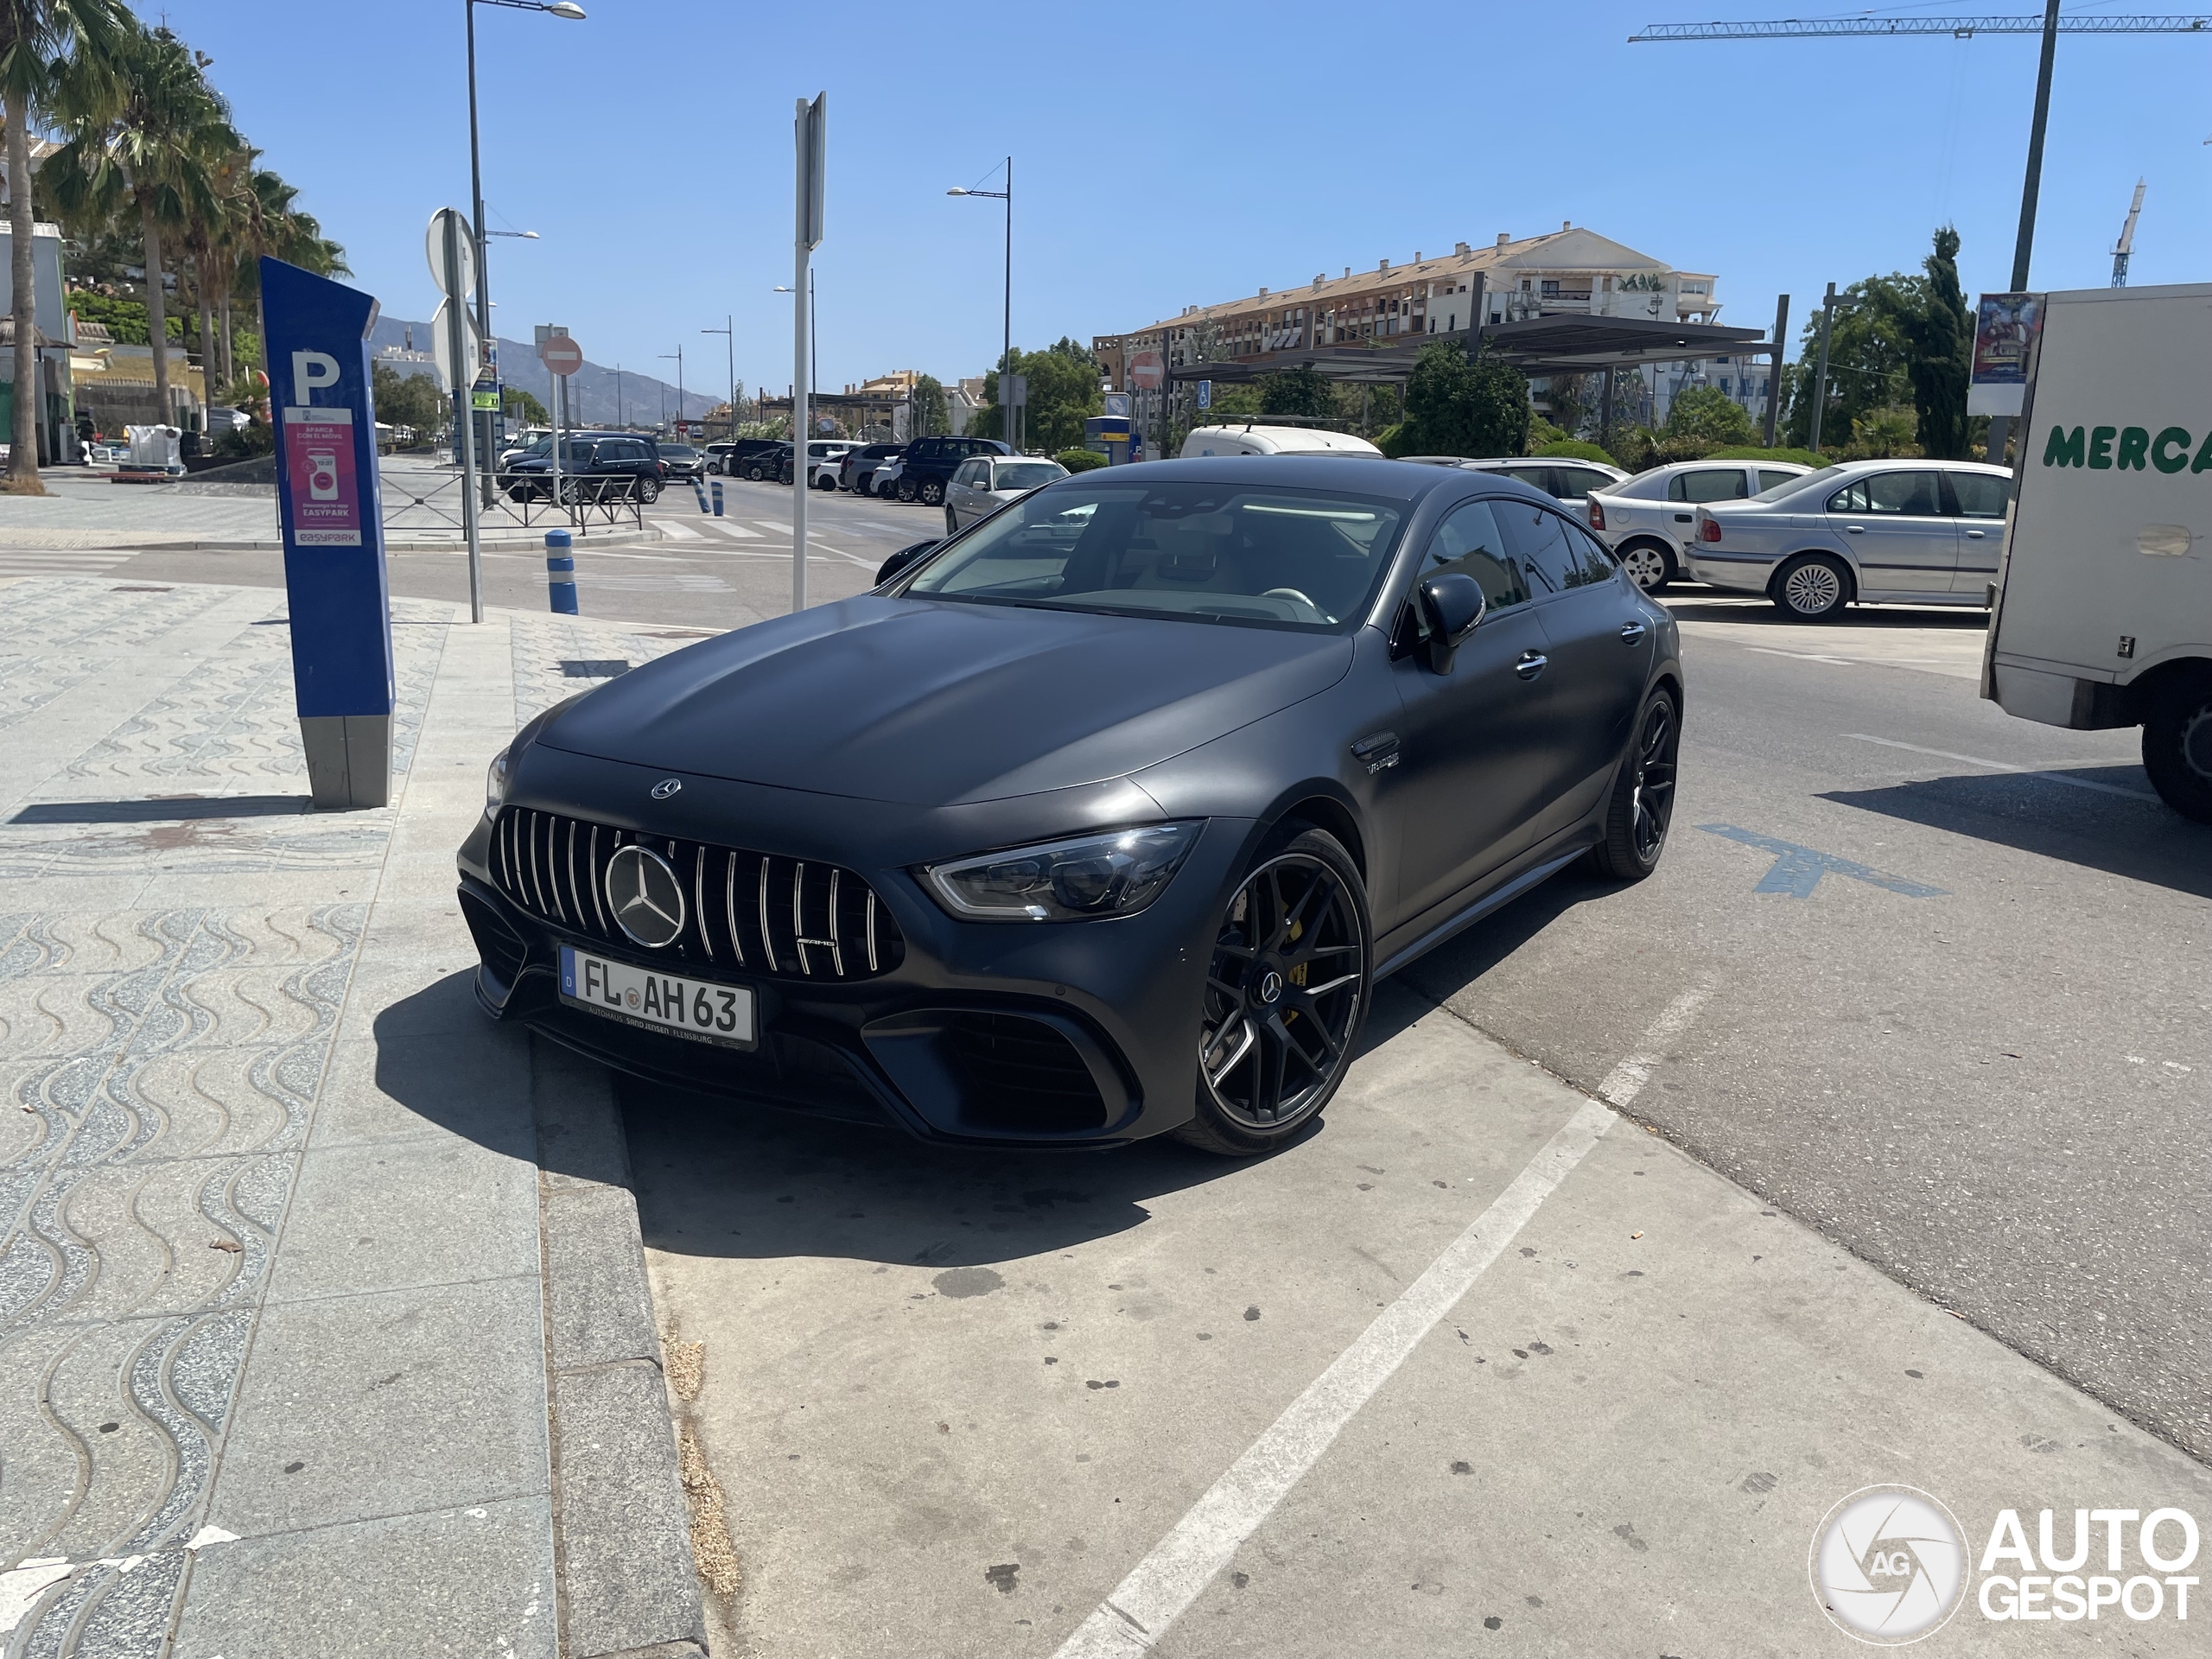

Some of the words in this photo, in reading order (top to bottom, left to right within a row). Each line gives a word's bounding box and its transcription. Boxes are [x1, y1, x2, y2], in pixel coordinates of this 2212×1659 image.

[291, 351, 340, 406] P
[565, 976, 572, 988] D
[585, 959, 621, 1006] FL
[644, 976, 685, 1023] AH
[693, 988, 736, 1032] 63
[588, 1006, 624, 1022] AUTOHAUS
[626, 1017, 645, 1029] SAND
[645, 1021, 670, 1034] JENSEN
[673, 1029, 713, 1045] FLENSBURG
